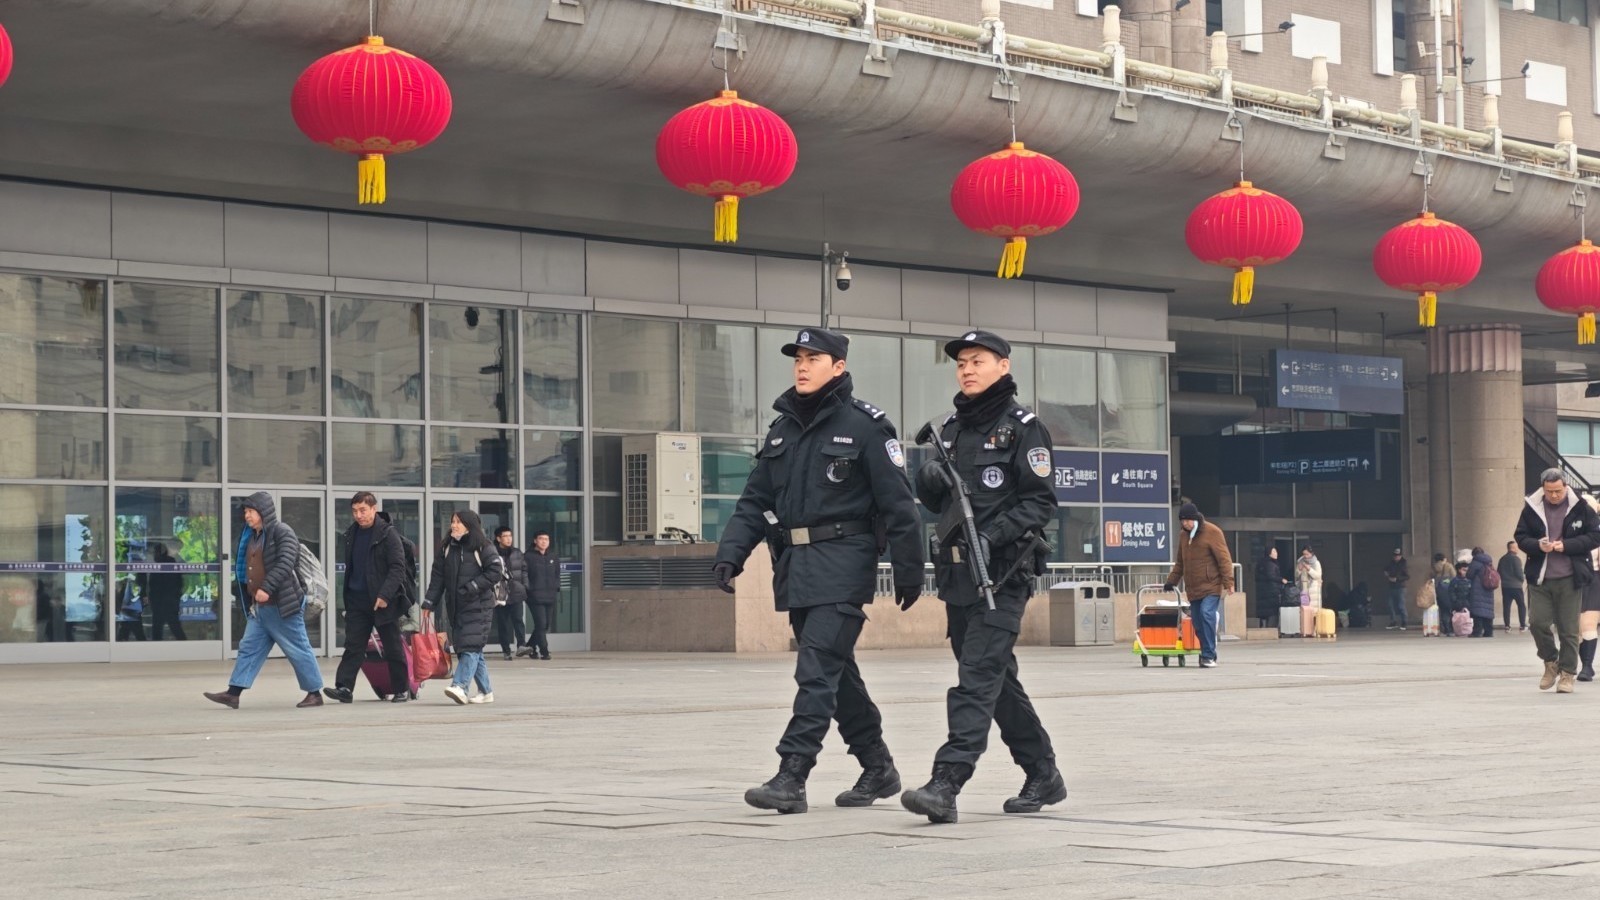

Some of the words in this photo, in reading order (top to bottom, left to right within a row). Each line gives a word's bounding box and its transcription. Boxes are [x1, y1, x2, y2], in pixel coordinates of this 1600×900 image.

[1122, 469, 1158, 480] 通往南广场
[1122, 522, 1155, 537] 餐饮区
[1156, 522, 1165, 531] B1
[1122, 539, 1138, 548] Dining
